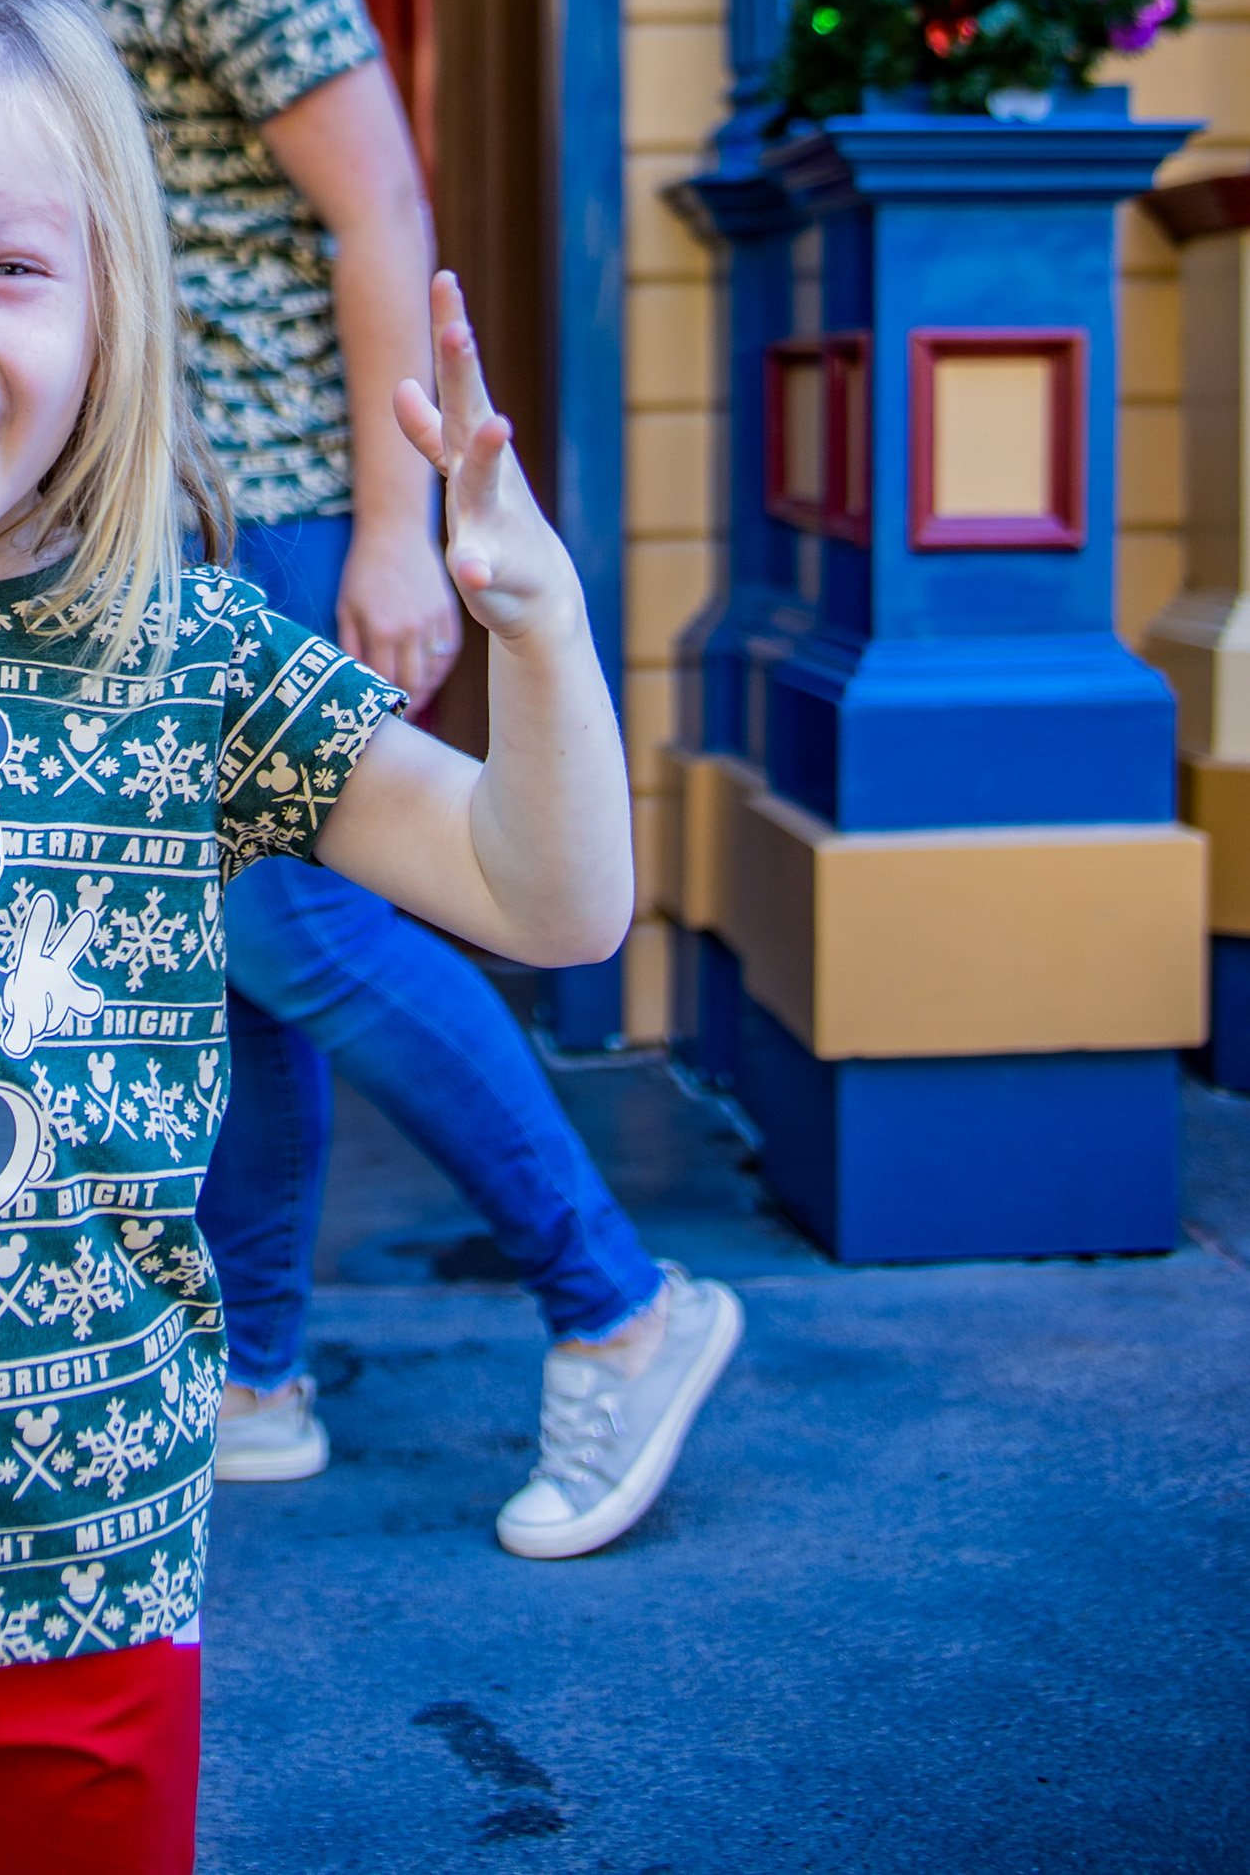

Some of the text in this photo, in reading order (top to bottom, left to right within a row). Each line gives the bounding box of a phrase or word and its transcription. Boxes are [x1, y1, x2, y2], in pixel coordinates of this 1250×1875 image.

[80, 673, 188, 706] MERRY
[274, 642, 340, 709] MERR
[2, 830, 106, 861] MERRY
[120, 837, 186, 866] AND
[102, 1009, 194, 1036] BRIGHT
[57, 1181, 159, 1217] BRIGHT
[143, 1306, 187, 1365] MERRY
[75, 1499, 169, 1553] MERRY
[181, 1466, 212, 1514] AND
